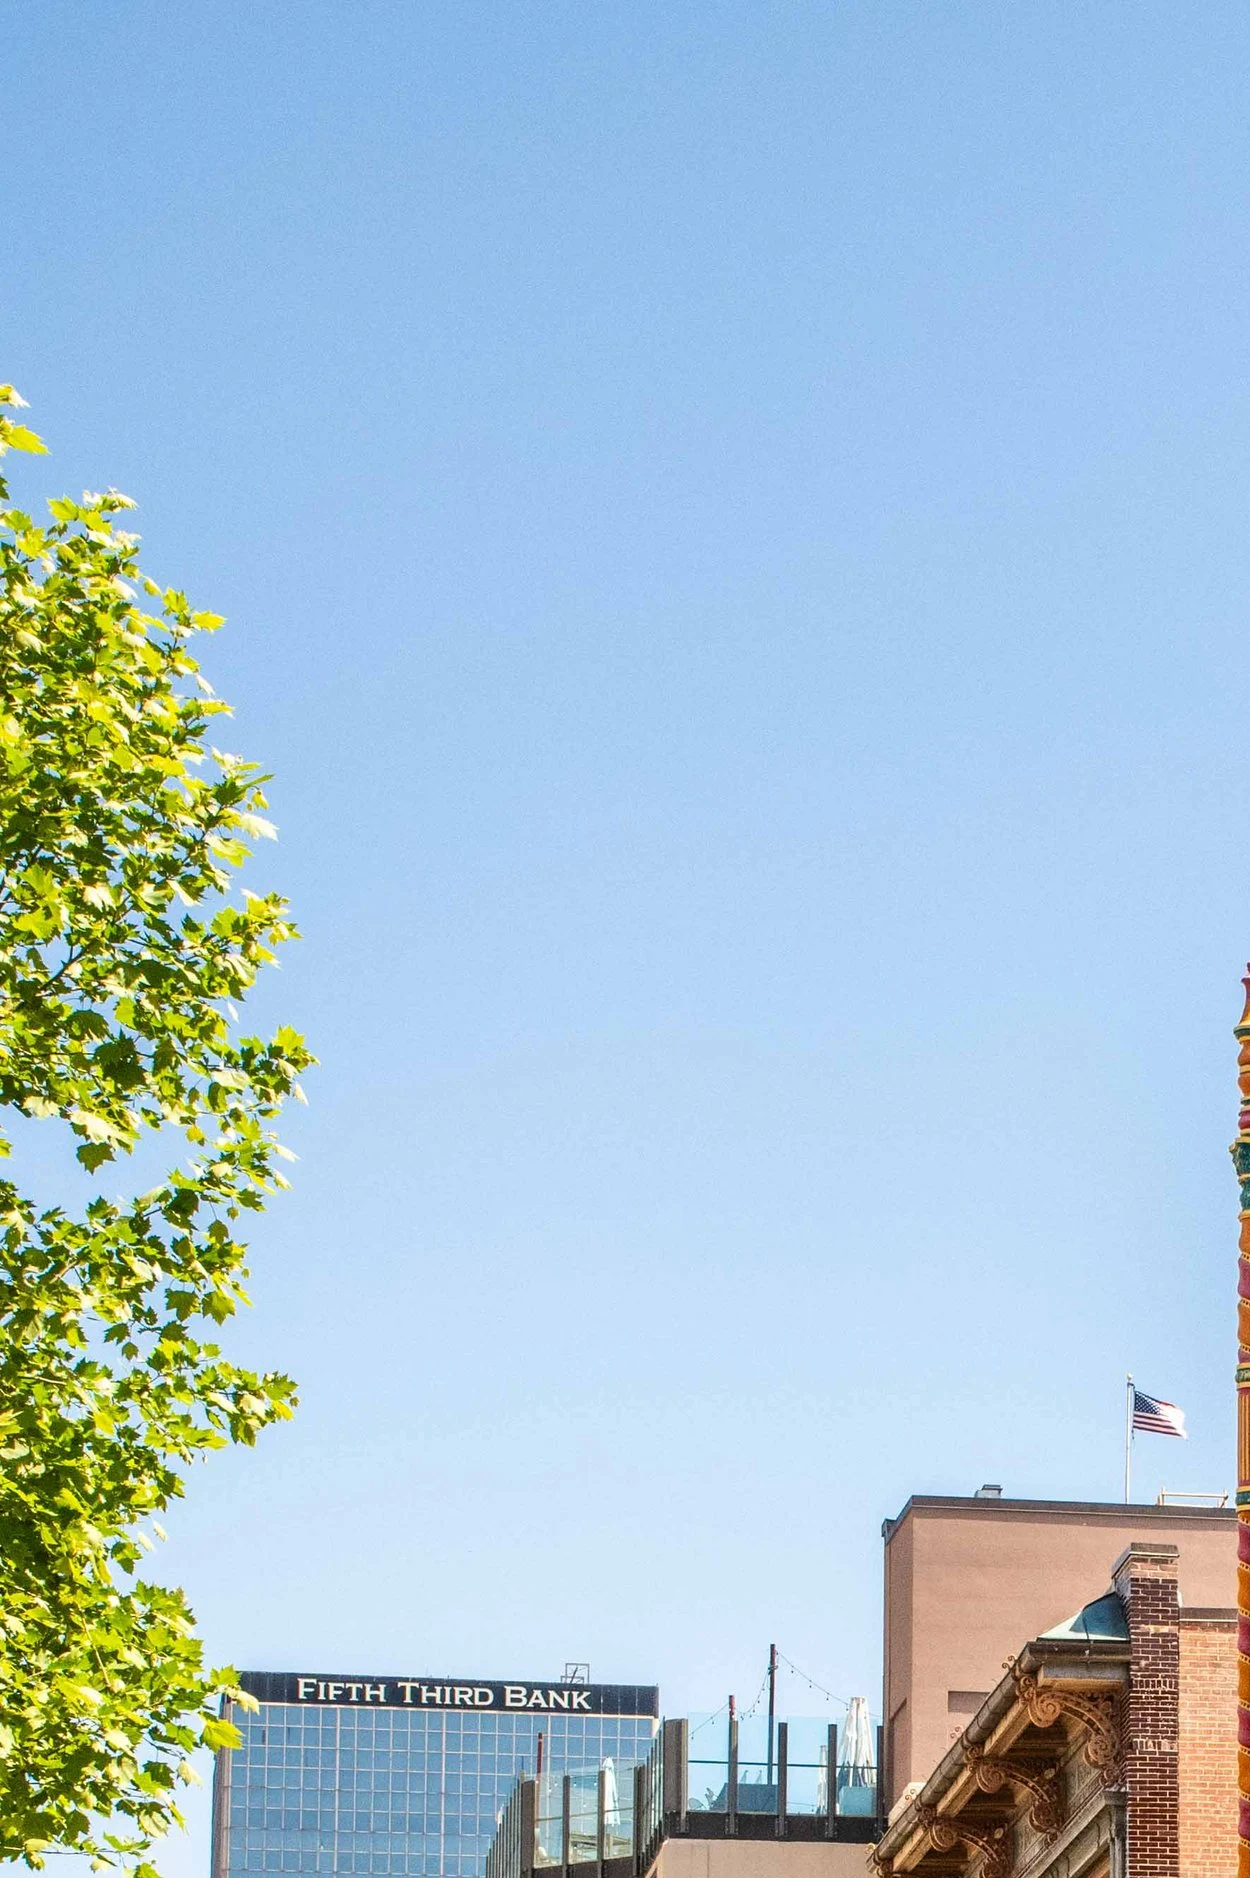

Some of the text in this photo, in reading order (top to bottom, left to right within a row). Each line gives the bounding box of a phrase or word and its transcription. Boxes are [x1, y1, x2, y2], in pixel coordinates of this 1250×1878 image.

[297, 1677, 592, 1710] FIFTH THIRD BANK
